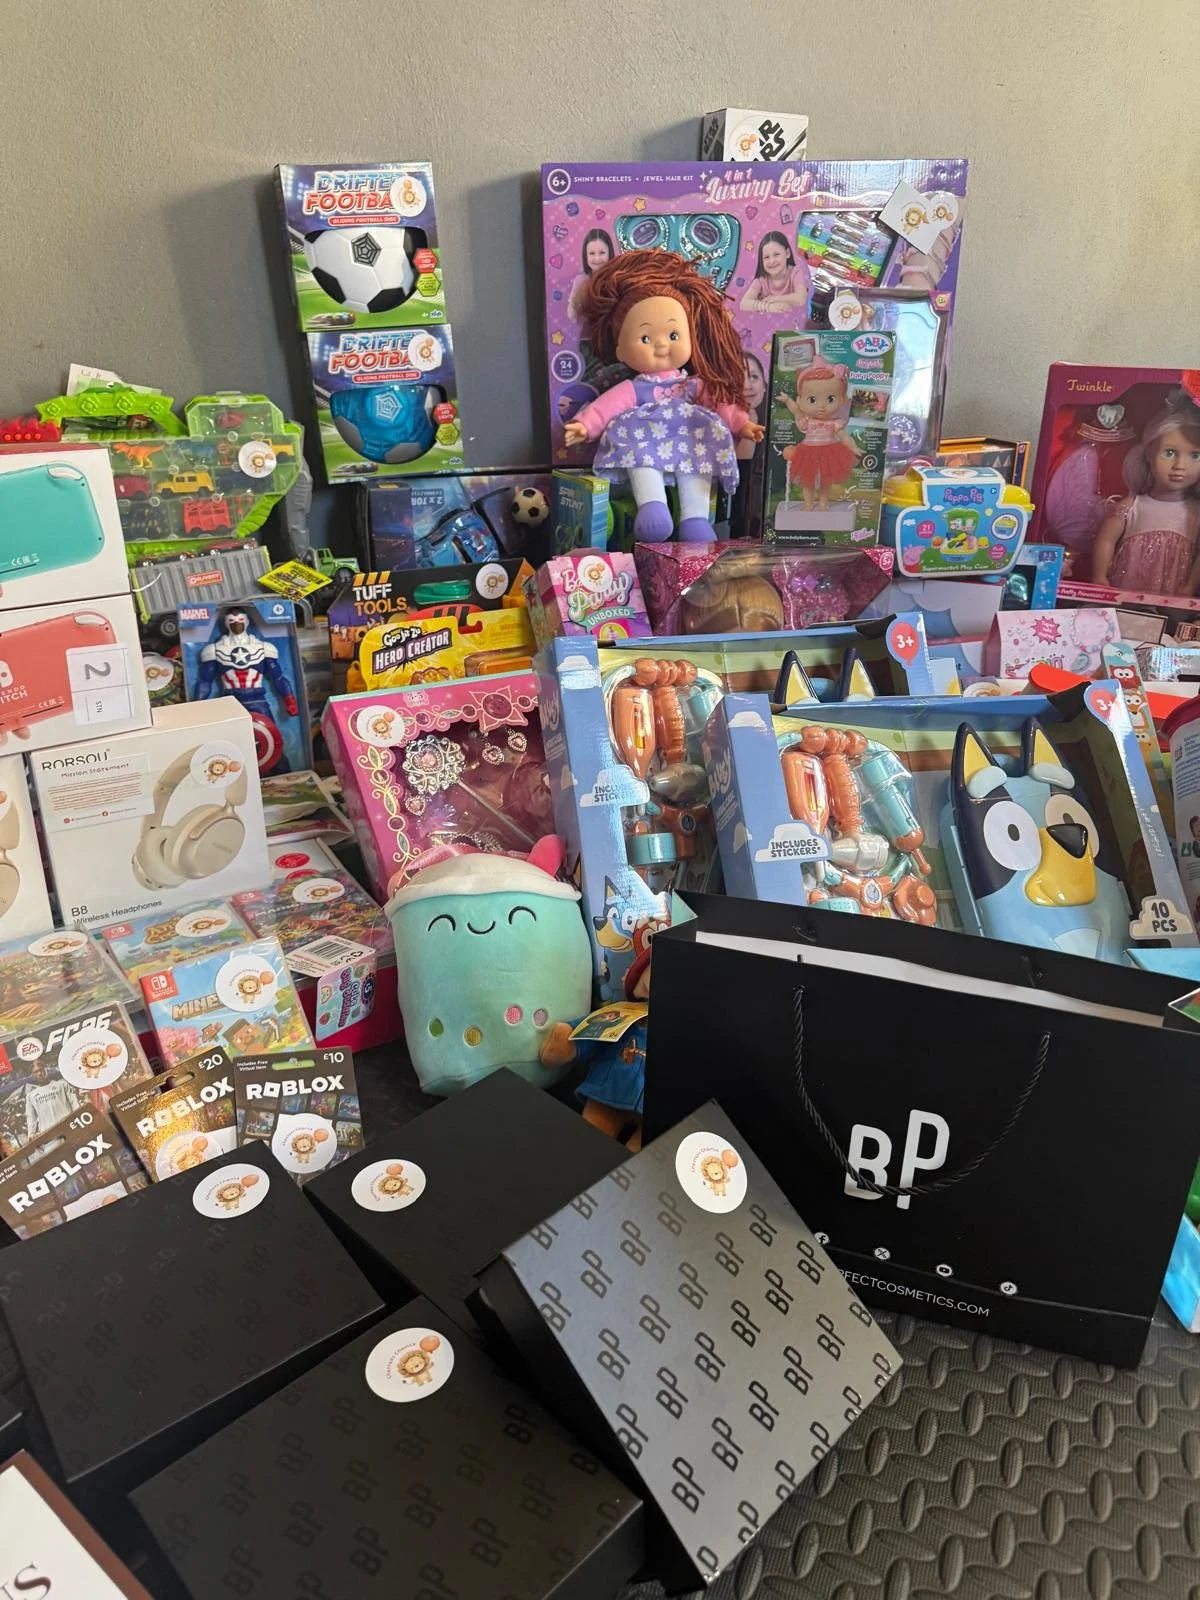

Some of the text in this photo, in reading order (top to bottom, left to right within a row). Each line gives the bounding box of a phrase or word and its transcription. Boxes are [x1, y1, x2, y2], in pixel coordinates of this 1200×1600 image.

[552, 176, 567, 187] 6+
[704, 168, 812, 204] Luxury Set
[306, 191, 396, 211] FOOTBA
[342, 333, 415, 353] DRIFTE
[855, 336, 888, 350] BABY
[332, 350, 412, 370] FOOTBA
[560, 360, 572, 369] 24
[868, 371, 889, 380] Poppy
[1067, 379, 1113, 392] Twinkle
[944, 488, 983, 506] Peppa Pig
[352, 583, 392, 601] TUFF
[180, 608, 210, 620] MARVEL
[353, 597, 408, 616] TOOLS
[588, 608, 630, 626] UNBOXED
[375, 632, 450, 671] HERO CREATOR
[896, 634, 914, 649] 3+
[84, 660, 111, 681] 2
[0, 689, 28, 704] ITCH
[89, 763, 130, 774] Statement
[771, 838, 818, 850] INCLUDES
[72, 905, 89, 918] B8
[111, 900, 163, 917] Headphones
[1151, 901, 1170, 918] 10
[1152, 918, 1178, 932] PCS
[198, 1053, 223, 1071] £20
[323, 1051, 345, 1065] £10
[246, 1074, 345, 1100] ROBLOX
[116, 1090, 148, 1108] Includes Free
[119, 1099, 136, 1113] Virtual
[136, 1076, 235, 1138] ROBLOX
[69, 1112, 93, 1130] £10
[844, 1109, 950, 1210] BP
[9, 1133, 113, 1214] ROBLOX
[657, 1191, 687, 1237] BP
[749, 1204, 777, 1247] BP
[620, 1220, 652, 1266] BP
[715, 1232, 744, 1277] BP
[797, 1240, 825, 1285] BP
[580, 1249, 613, 1299] BP
[678, 1262, 708, 1310] BP
[765, 1269, 794, 1315] BP
[539, 1281, 572, 1332] BP
[639, 1294, 671, 1344] BP
[731, 1300, 761, 1348] BP
[816, 1314, 845, 1362] BP
[597, 1328, 630, 1381] BP
[695, 1332, 726, 1383] BP
[783, 1346, 813, 1396] BP
[656, 1366, 688, 1420] BP
[749, 1380, 779, 1432] BP
[616, 1403, 649, 1460] BP
[712, 1417, 744, 1472] BP
[672, 1457, 705, 1514] BP
